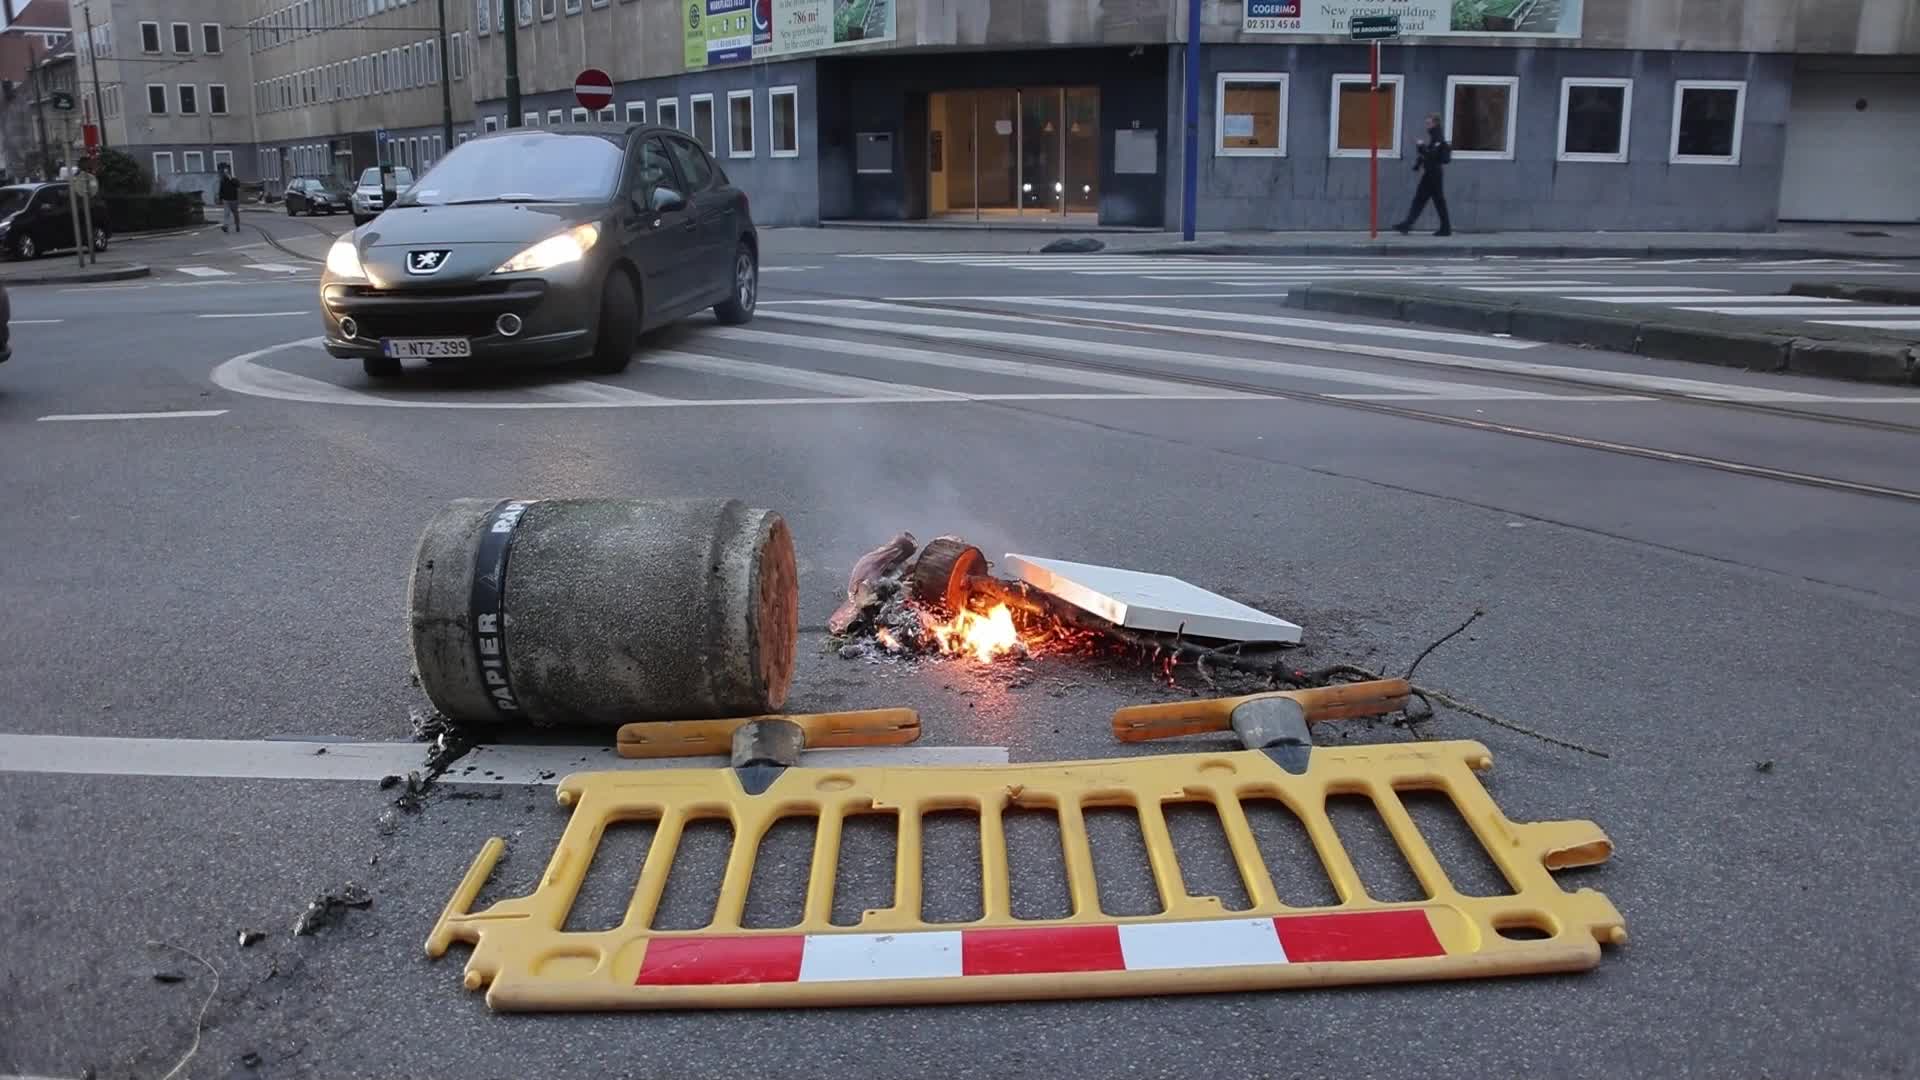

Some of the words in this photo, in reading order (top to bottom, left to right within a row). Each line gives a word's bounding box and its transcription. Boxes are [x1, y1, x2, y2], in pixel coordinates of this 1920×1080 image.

[1252, 4, 1297, 14] COGERIMO
[1321, 5, 1346, 16] New
[1388, 5, 1437, 20] building
[1247, 20, 1258, 28] 02
[1260, 20, 1275, 28] 513
[1278, 20, 1288, 28] 45
[1290, 20, 1301, 28] 68
[1331, 19, 1344, 29] In
[478, 613, 519, 710] PAPIER
